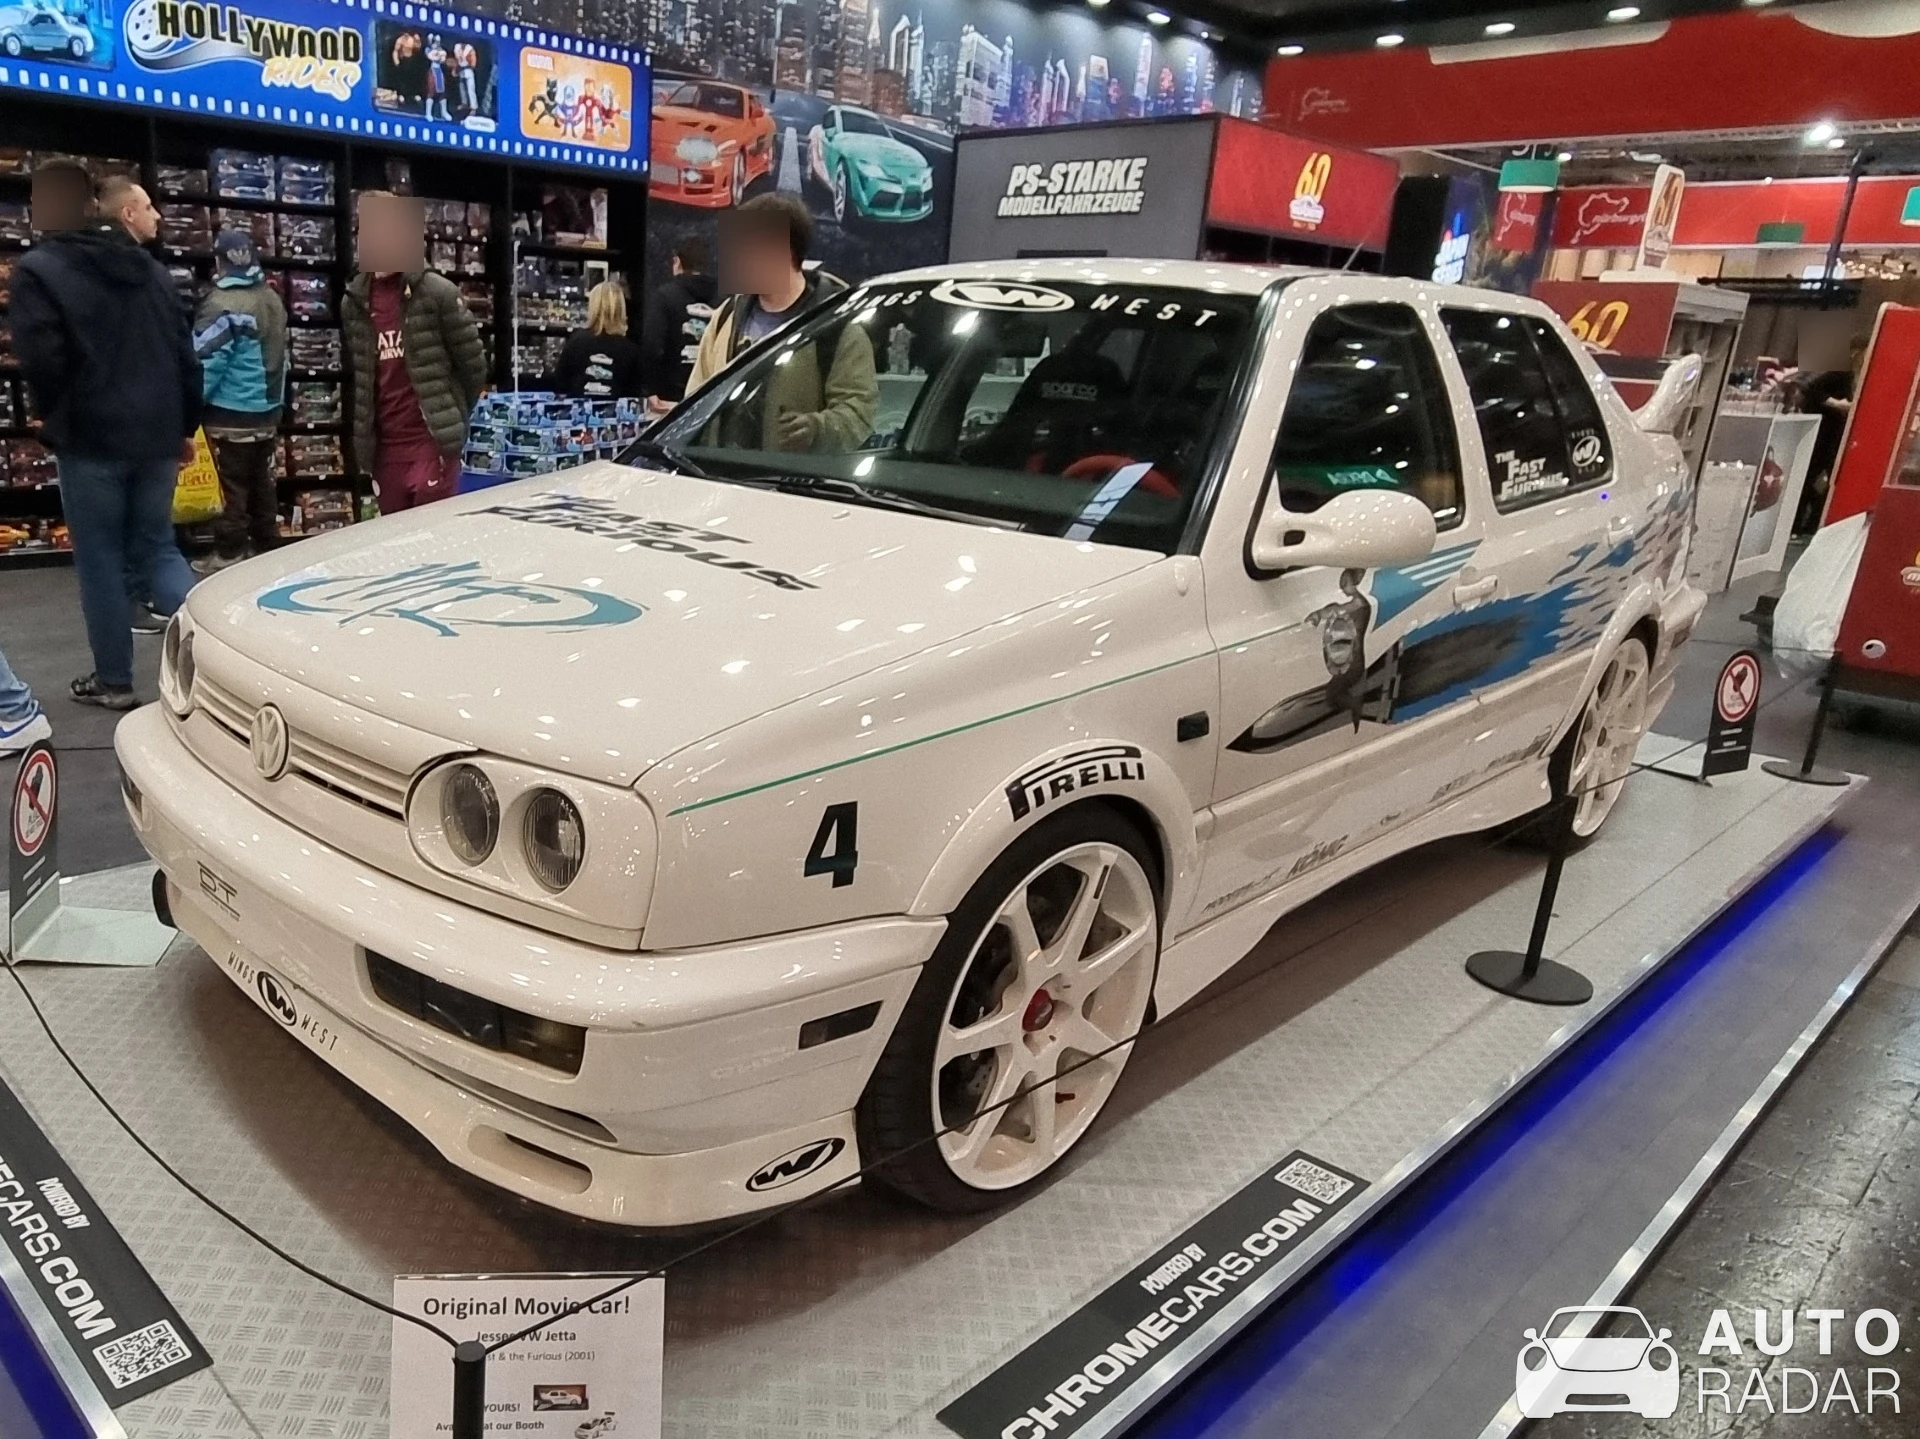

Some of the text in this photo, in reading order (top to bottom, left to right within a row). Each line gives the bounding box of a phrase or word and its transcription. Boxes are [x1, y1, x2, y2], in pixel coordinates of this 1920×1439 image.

[156, 1, 361, 64] HOLLYWOOD
[262, 56, 361, 101] RIDES
[1007, 157, 1148, 196] PS-STARKE
[997, 191, 1145, 217] MODELLFAHRZEUGE
[1090, 294, 1217, 326] WEST
[1567, 301, 1629, 349] 60
[1507, 457, 1546, 480] FAST
[454, 505, 822, 590] FURIOUS
[1004, 745, 1145, 823] PIRELLI
[804, 801, 858, 888] 4
[228, 951, 255, 984] WINGS
[301, 1013, 338, 1051] WEST
[423, 1295, 630, 1320] Original Movie Car!
[1001, 1198, 1323, 1439] CHROMECARS.COM
[477, 1331, 516, 1344] Jesse
[545, 1330, 577, 1342] Jetta
[499, 1353, 506, 1362] &
[509, 1351, 525, 1362] the
[528, 1351, 562, 1362] Furious
[565, 1350, 596, 1363] (2001)
[515, 1420, 545, 1431] Booth
